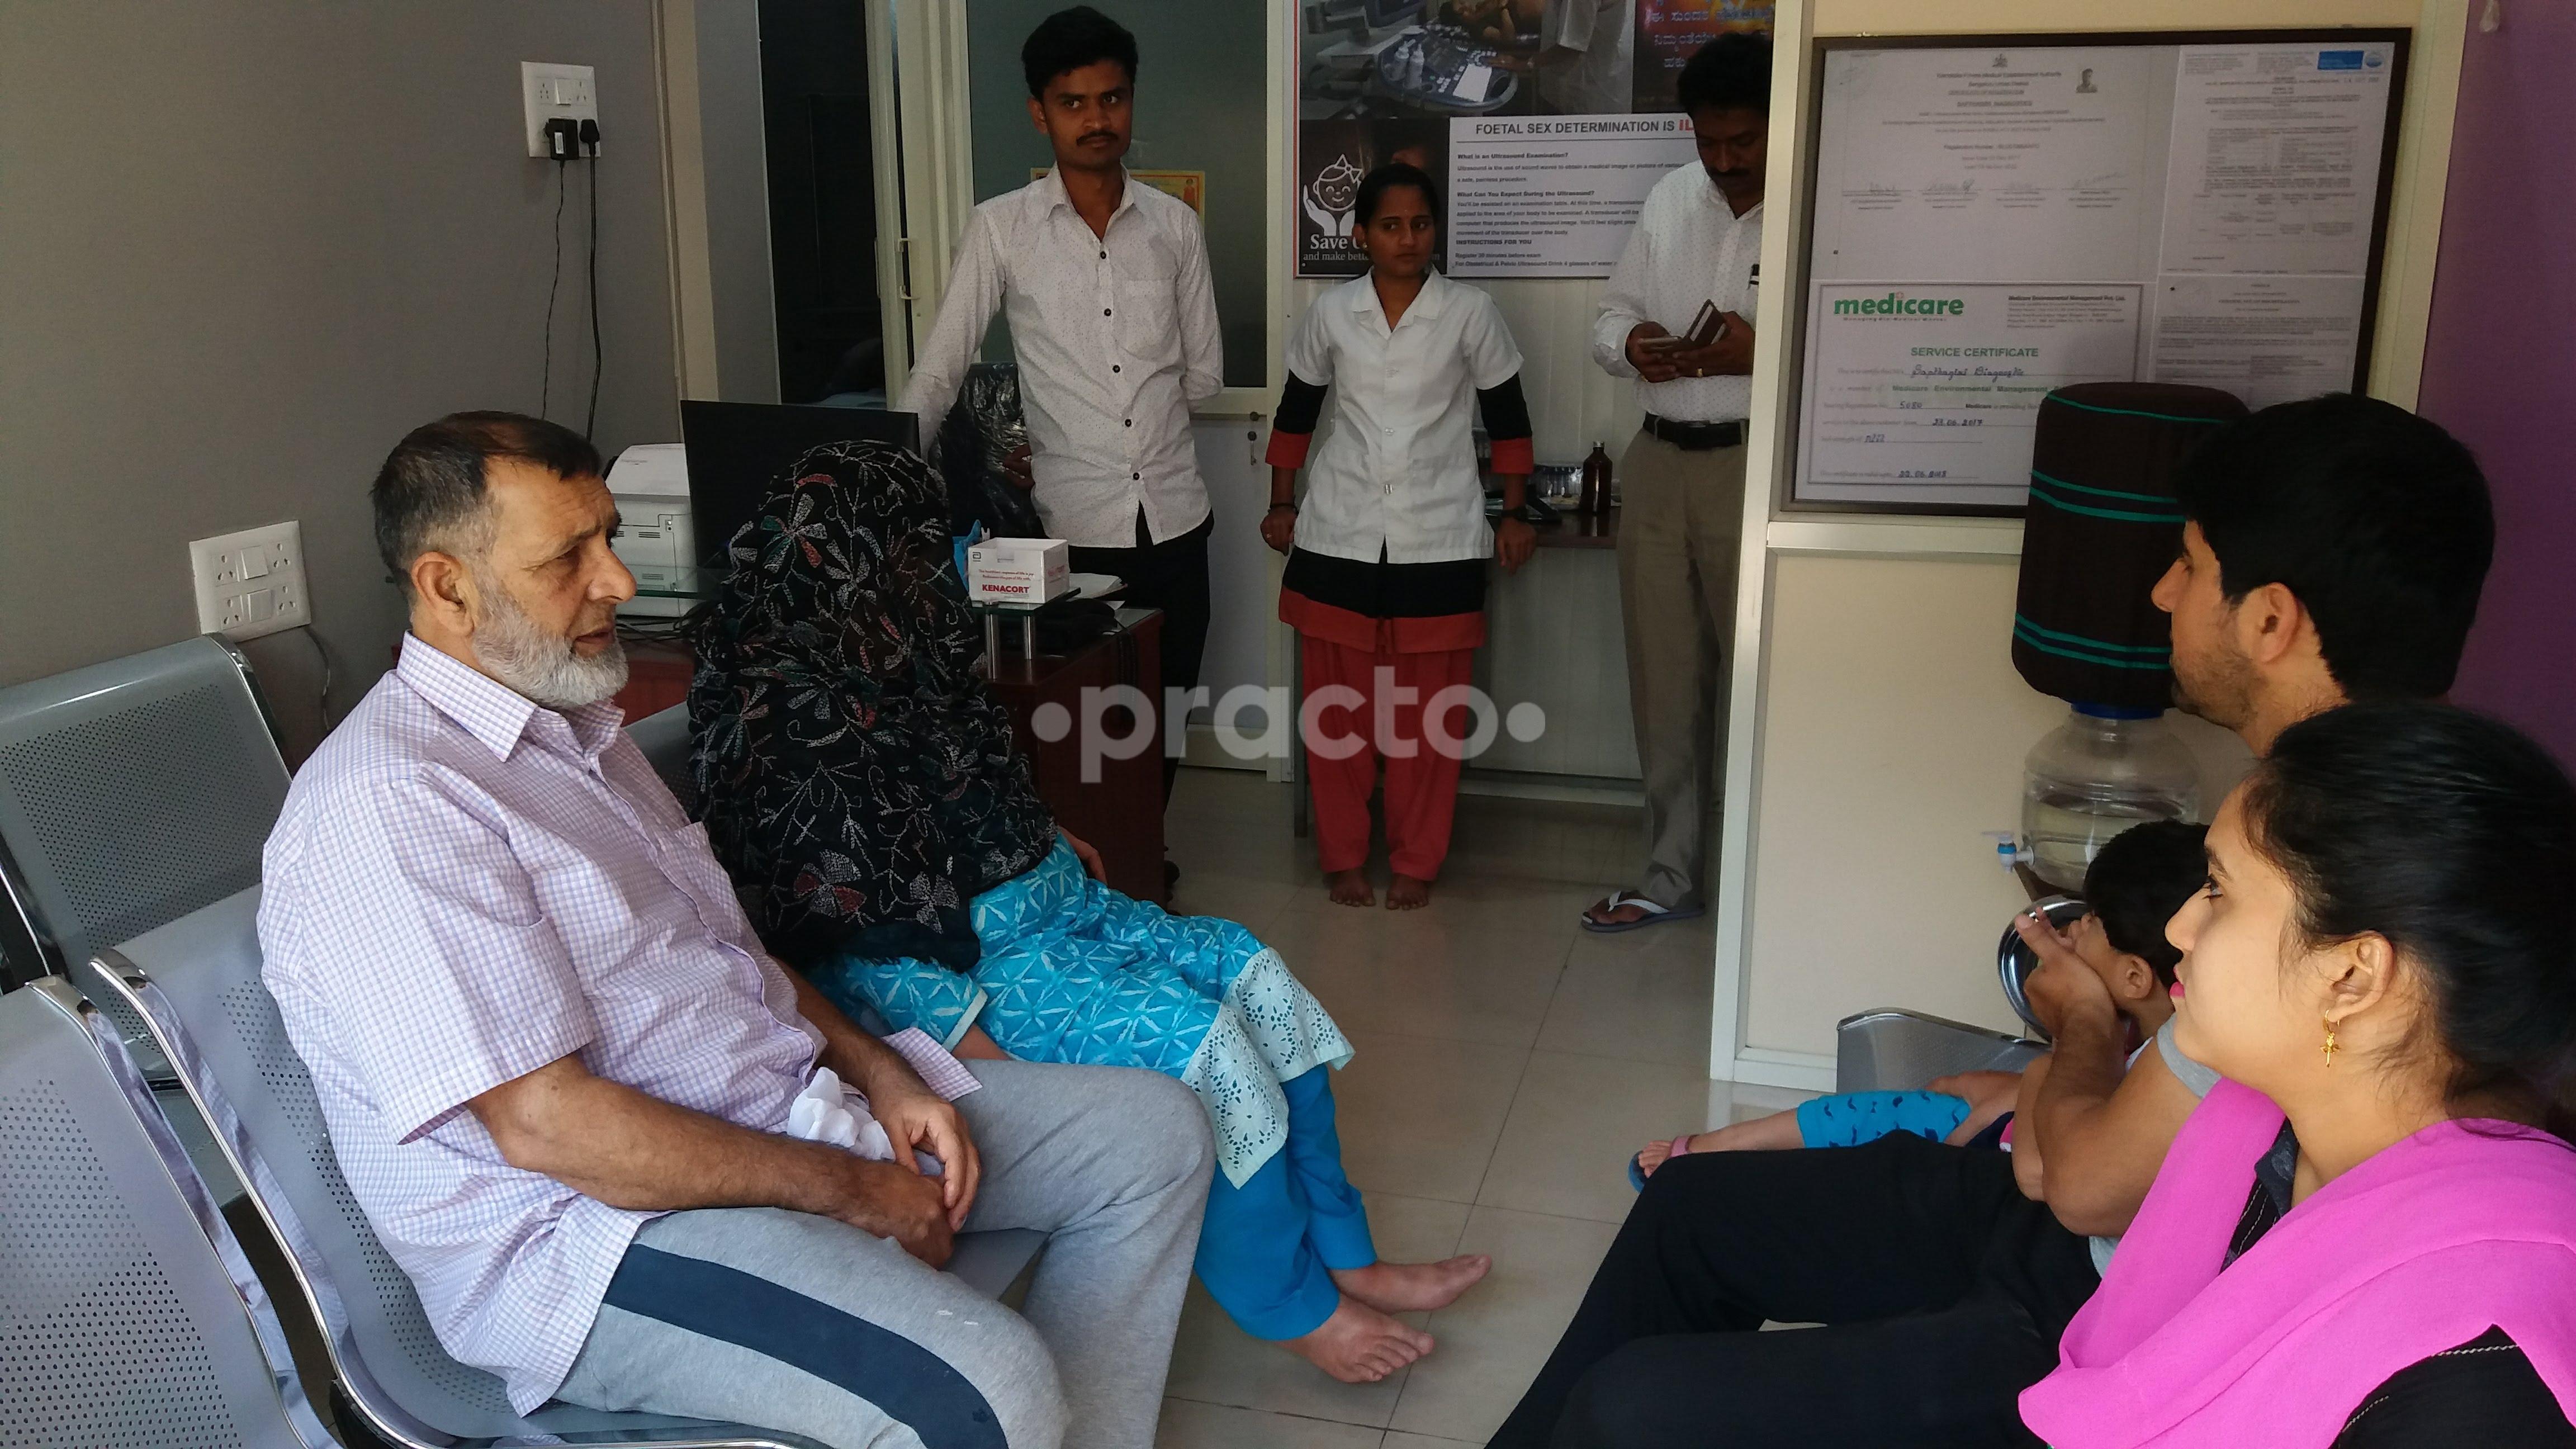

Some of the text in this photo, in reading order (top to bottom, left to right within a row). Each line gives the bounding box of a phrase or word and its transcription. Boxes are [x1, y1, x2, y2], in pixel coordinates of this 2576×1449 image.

[1476, 119, 1694, 134] FOETAL SEX DETERMINATION IS IL
[1310, 234, 1348, 249] Save
[1303, 252, 1369, 261] and make bett
[1834, 292, 1964, 315] medicare
[1911, 347, 2039, 357] SERVICE CERTIFICATE
[982, 584, 1030, 594] KENACORT
